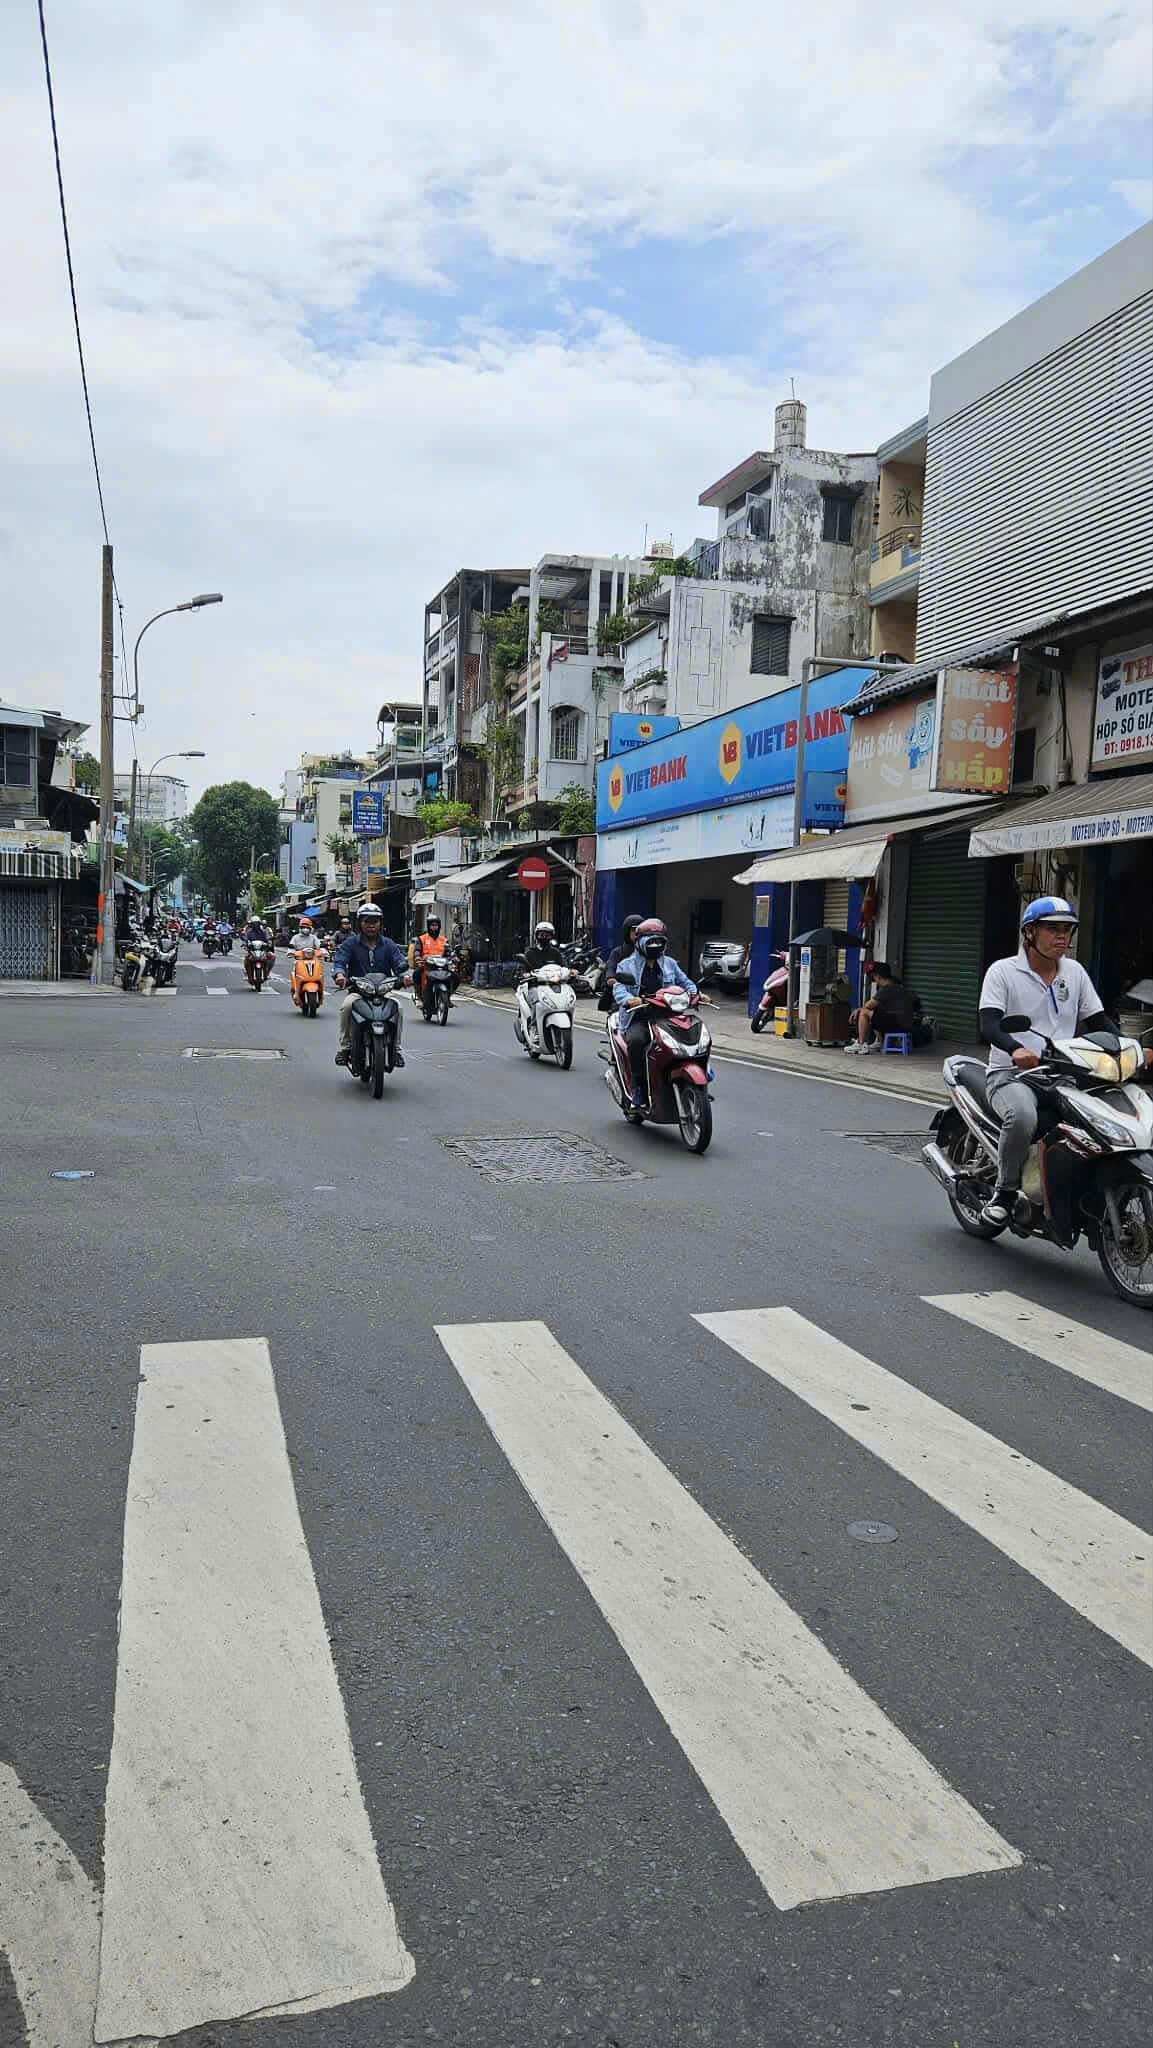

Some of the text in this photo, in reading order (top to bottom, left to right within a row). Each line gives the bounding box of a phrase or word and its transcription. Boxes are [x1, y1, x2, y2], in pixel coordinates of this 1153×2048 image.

[1115, 687, 1153, 712] MOTE
[1097, 719, 1118, 742] HỘP
[1121, 709, 1135, 735] SỐ
[626, 755, 688, 794] VIETBANK
[1071, 823, 1096, 840] MOTEUR
